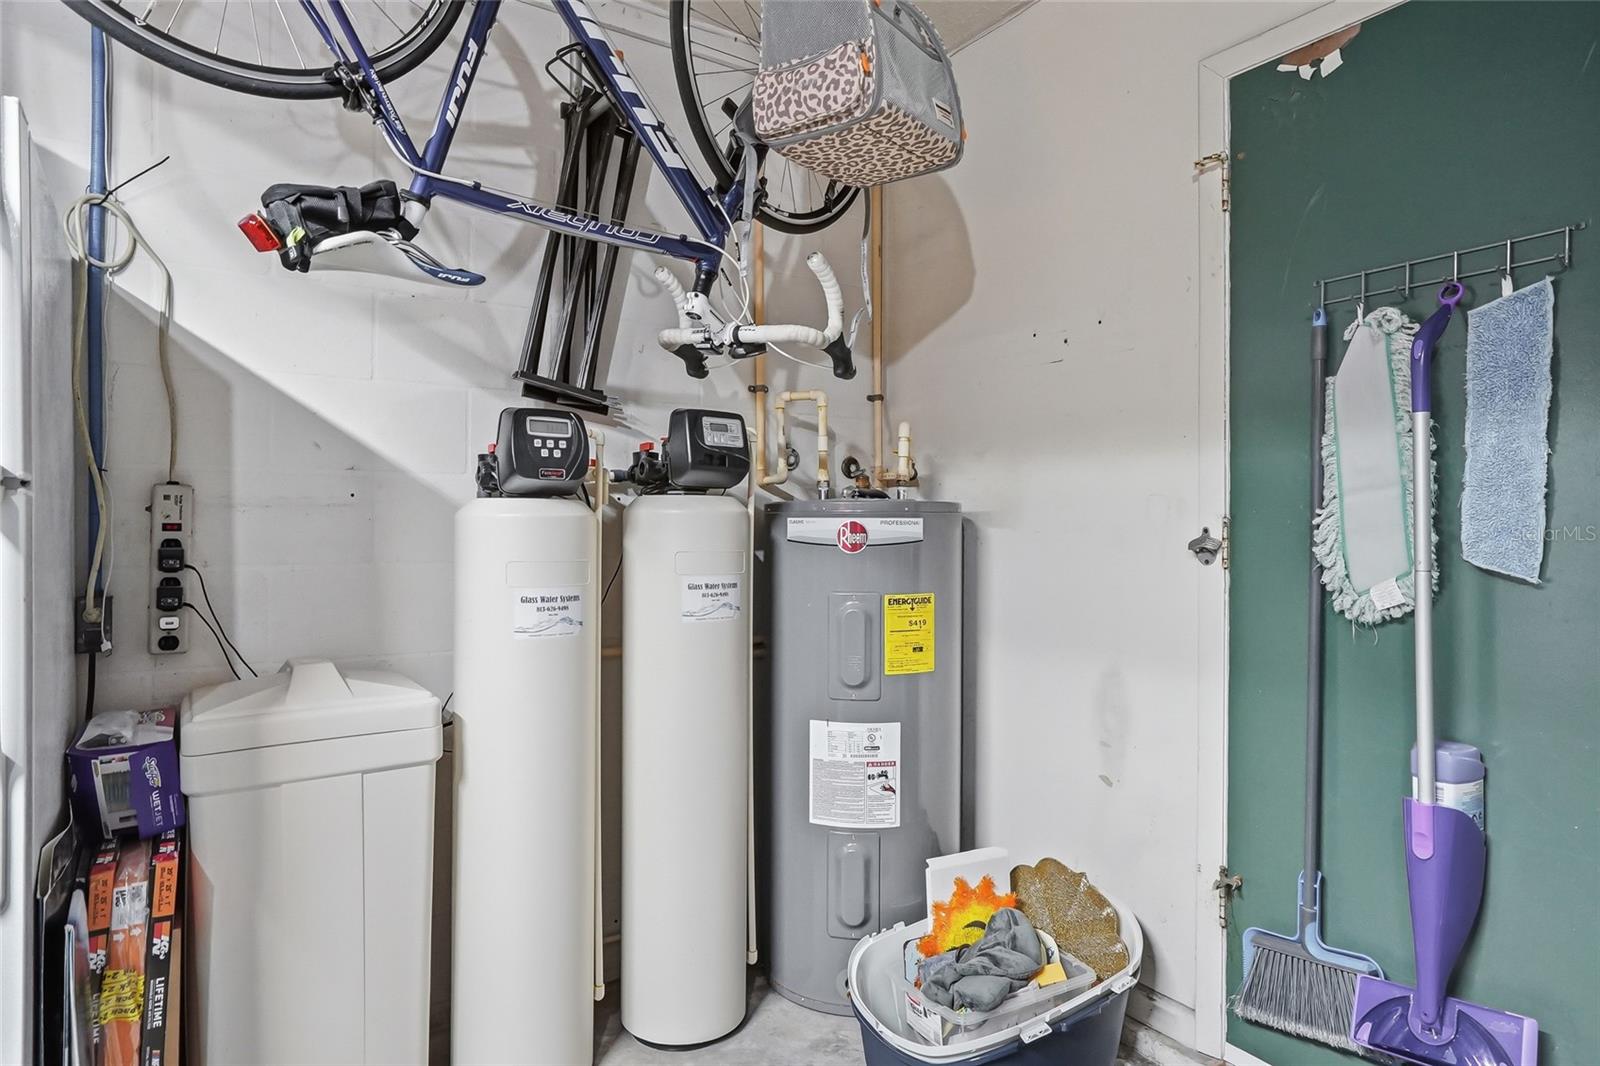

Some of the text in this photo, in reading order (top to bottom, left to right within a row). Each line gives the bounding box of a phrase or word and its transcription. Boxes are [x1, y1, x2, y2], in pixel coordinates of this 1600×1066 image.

[445, 38, 479, 128] FUJI
[438, 273, 470, 283] FUJI
[840, 521, 867, 548] Rheem
[520, 595, 538, 604] Glass
[540, 595, 558, 603] Water
[888, 597, 932, 606] ENERGYGUIDE
[152, 935, 169, 960] K&N
[153, 977, 165, 1029] LIFETIME
